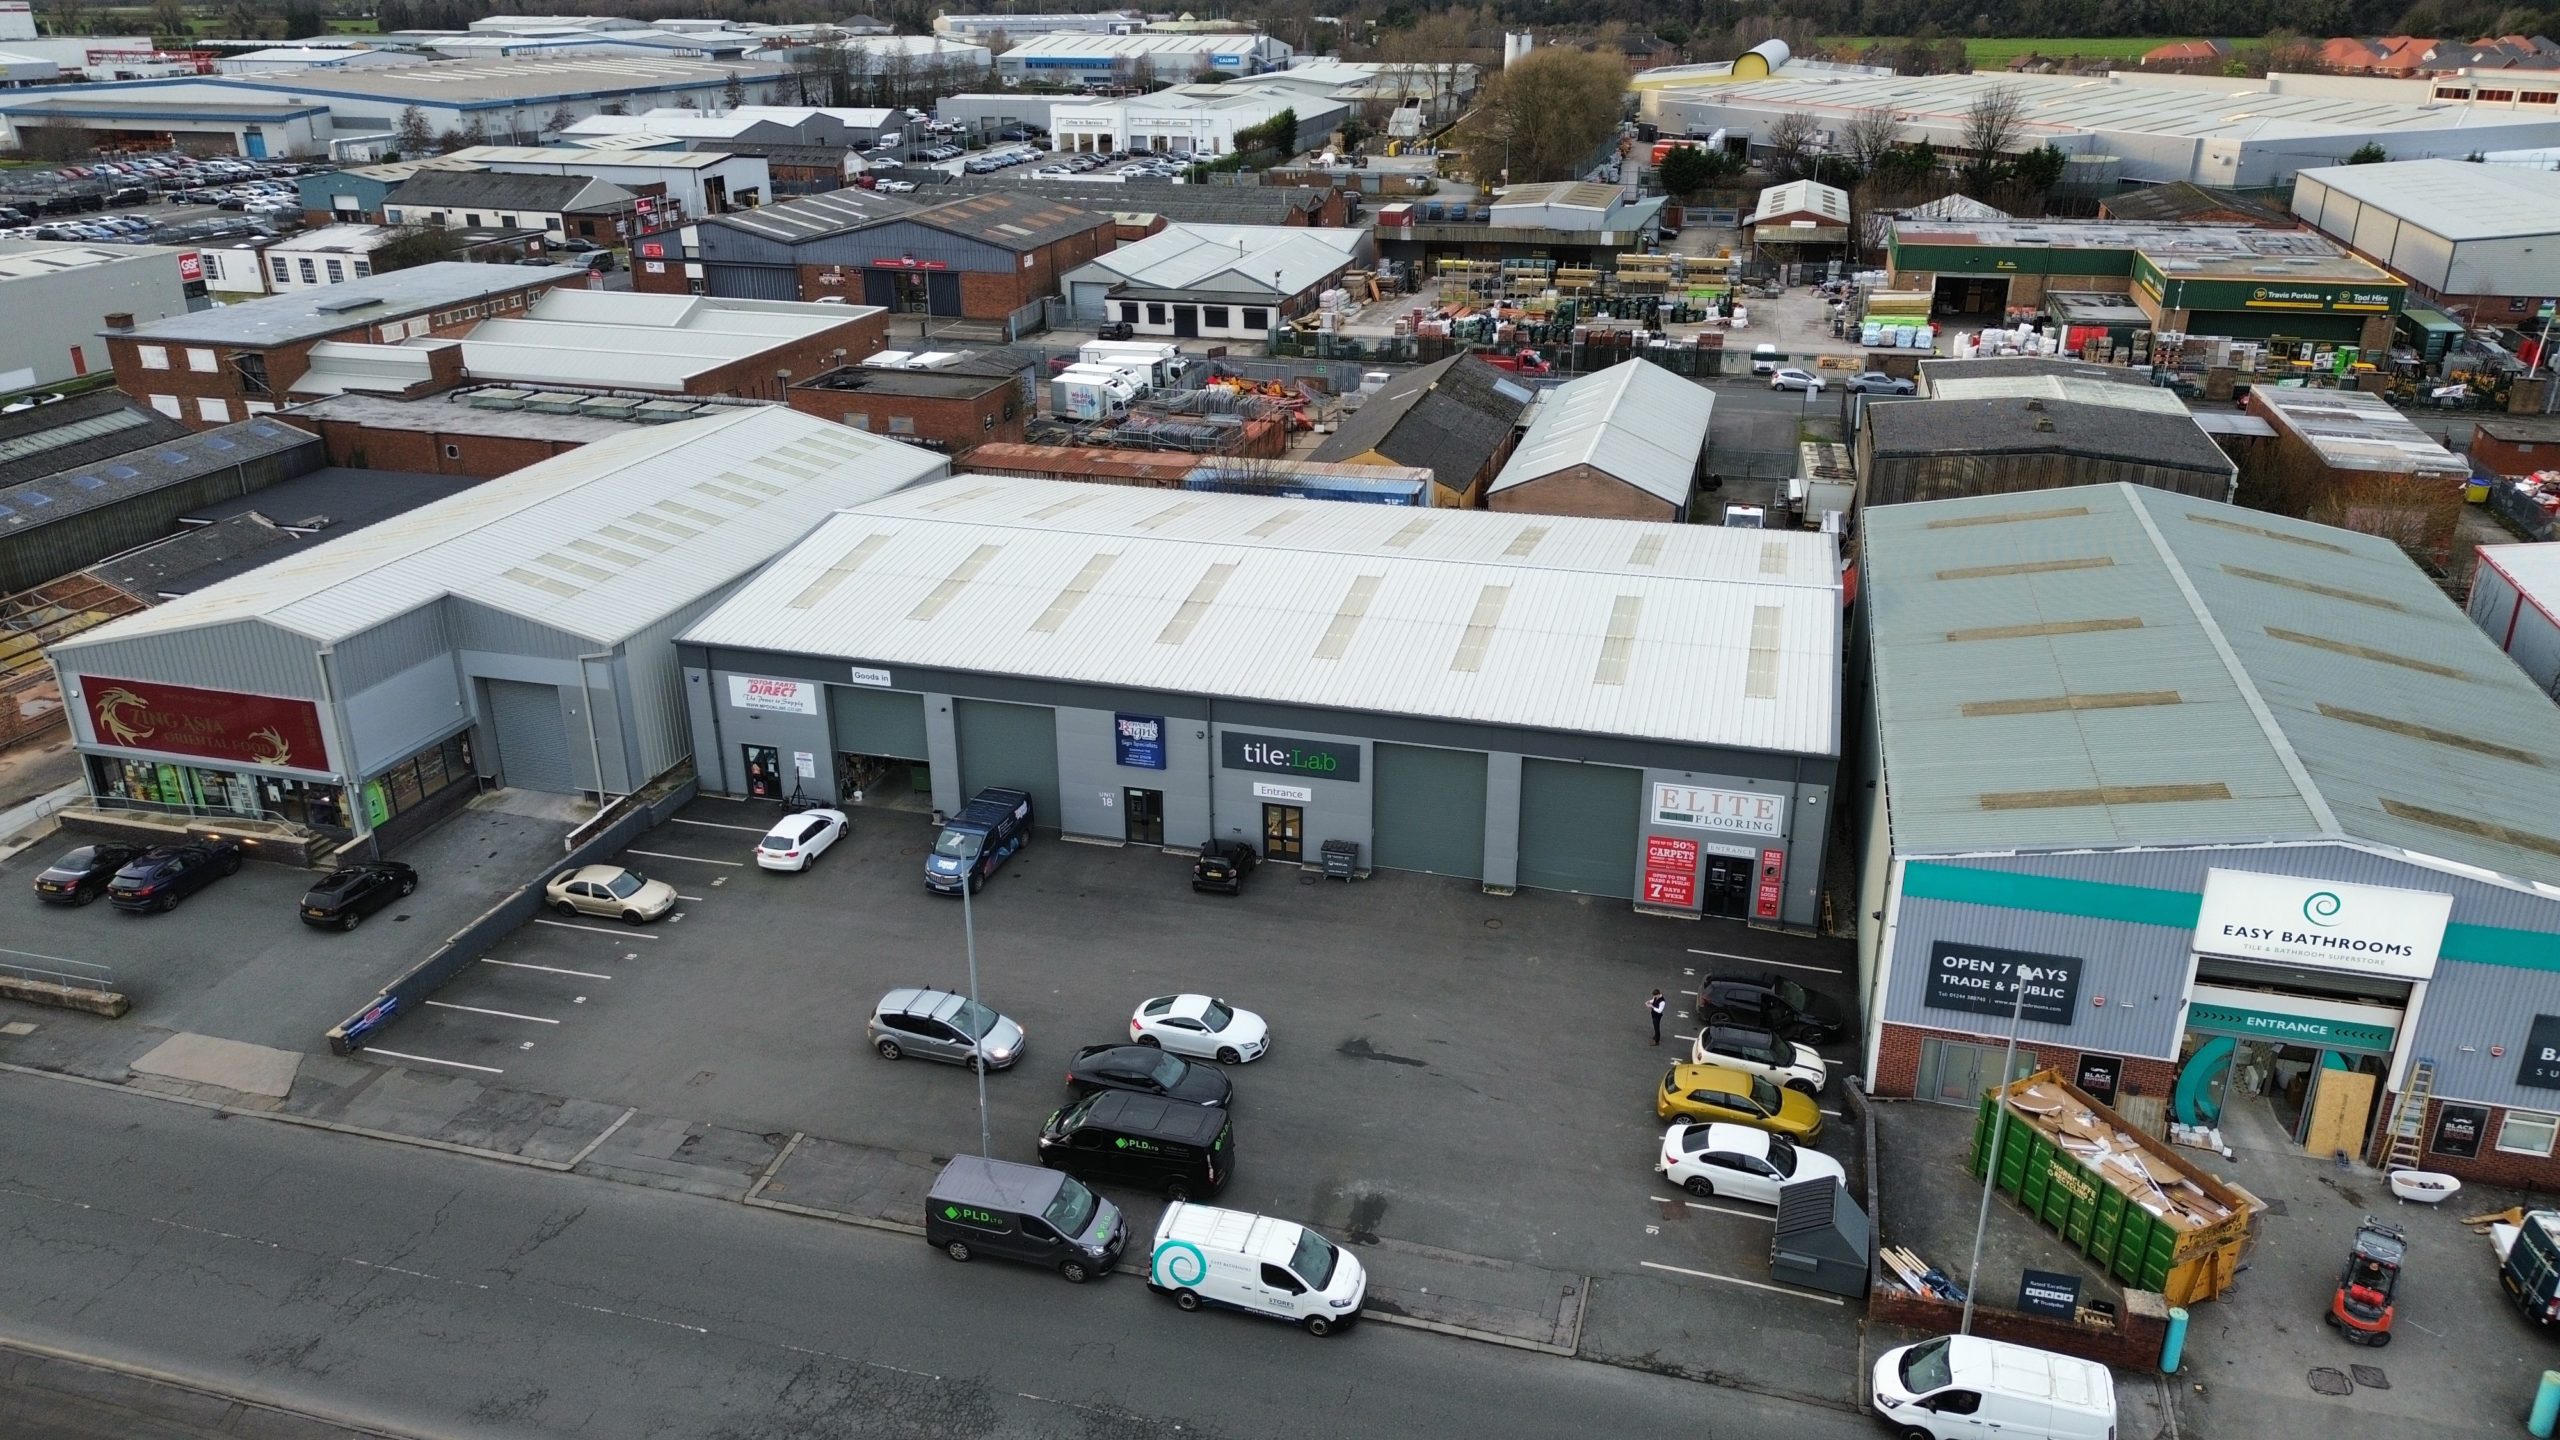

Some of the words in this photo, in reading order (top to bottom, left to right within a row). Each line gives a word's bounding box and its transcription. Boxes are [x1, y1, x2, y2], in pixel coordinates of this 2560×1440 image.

[181, 258, 198, 270] GSF
[2268, 291, 2290, 299] Travis
[2290, 291, 2319, 300] Perkins
[2353, 293, 2371, 301] Tool
[2371, 294, 2389, 302] Hire
[747, 678, 773, 686] MOTOR
[854, 671, 879, 681] Goods
[881, 674, 889, 682] in
[747, 684, 797, 698] DIRECT
[184, 713, 226, 734] ASIA
[1122, 727, 1158, 741] Signs
[164, 732, 230, 750] ORIENTAL
[1243, 743, 1337, 771] tile:Lab
[1261, 786, 1303, 799] Entrance
[1102, 797, 1113, 807] 18
[1660, 788, 1774, 820] ELITE
[1696, 814, 1772, 831] FLOORING
[1673, 841, 1696, 850] 50%
[1710, 845, 1753, 856] ENTRANCE
[1650, 847, 1694, 860] CARPETS
[1765, 851, 1781, 859] FREE
[1650, 883, 1663, 898] 7
[1663, 886, 1680, 894] DAYS
[1761, 885, 1777, 893] FREE
[1664, 892, 1684, 900] WEEK
[2223, 924, 2274, 941] EASY
[2281, 931, 2413, 957] BATHROOMS
[2243, 943, 2261, 952] TILE
[2273, 946, 2325, 960] BATHROOM
[2328, 953, 2385, 967] SUPERSTORE
[1942, 956, 1995, 973] OPEN
[2001, 963, 2011, 975] 7
[1940, 974, 1991, 990] TRADE
[1994, 981, 2005, 992] &
[2246, 1016, 2329, 1035] ENTRANCE
[519, 1041, 534, 1050] 18
[2084, 1072, 2111, 1081] BLACK
[2445, 1122, 2475, 1131] BLACK
[1129, 1139, 1149, 1149] PLD
[2049, 1159, 2097, 1199] THORNCLIFFE
[963, 1209, 990, 1222] PLD
[990, 1217, 1003, 1225] LTD
[2030, 1280, 2046, 1288] Rated
[1269, 1297, 1295, 1307] STORES
[2040, 1300, 2065, 1309] Trustpilot
